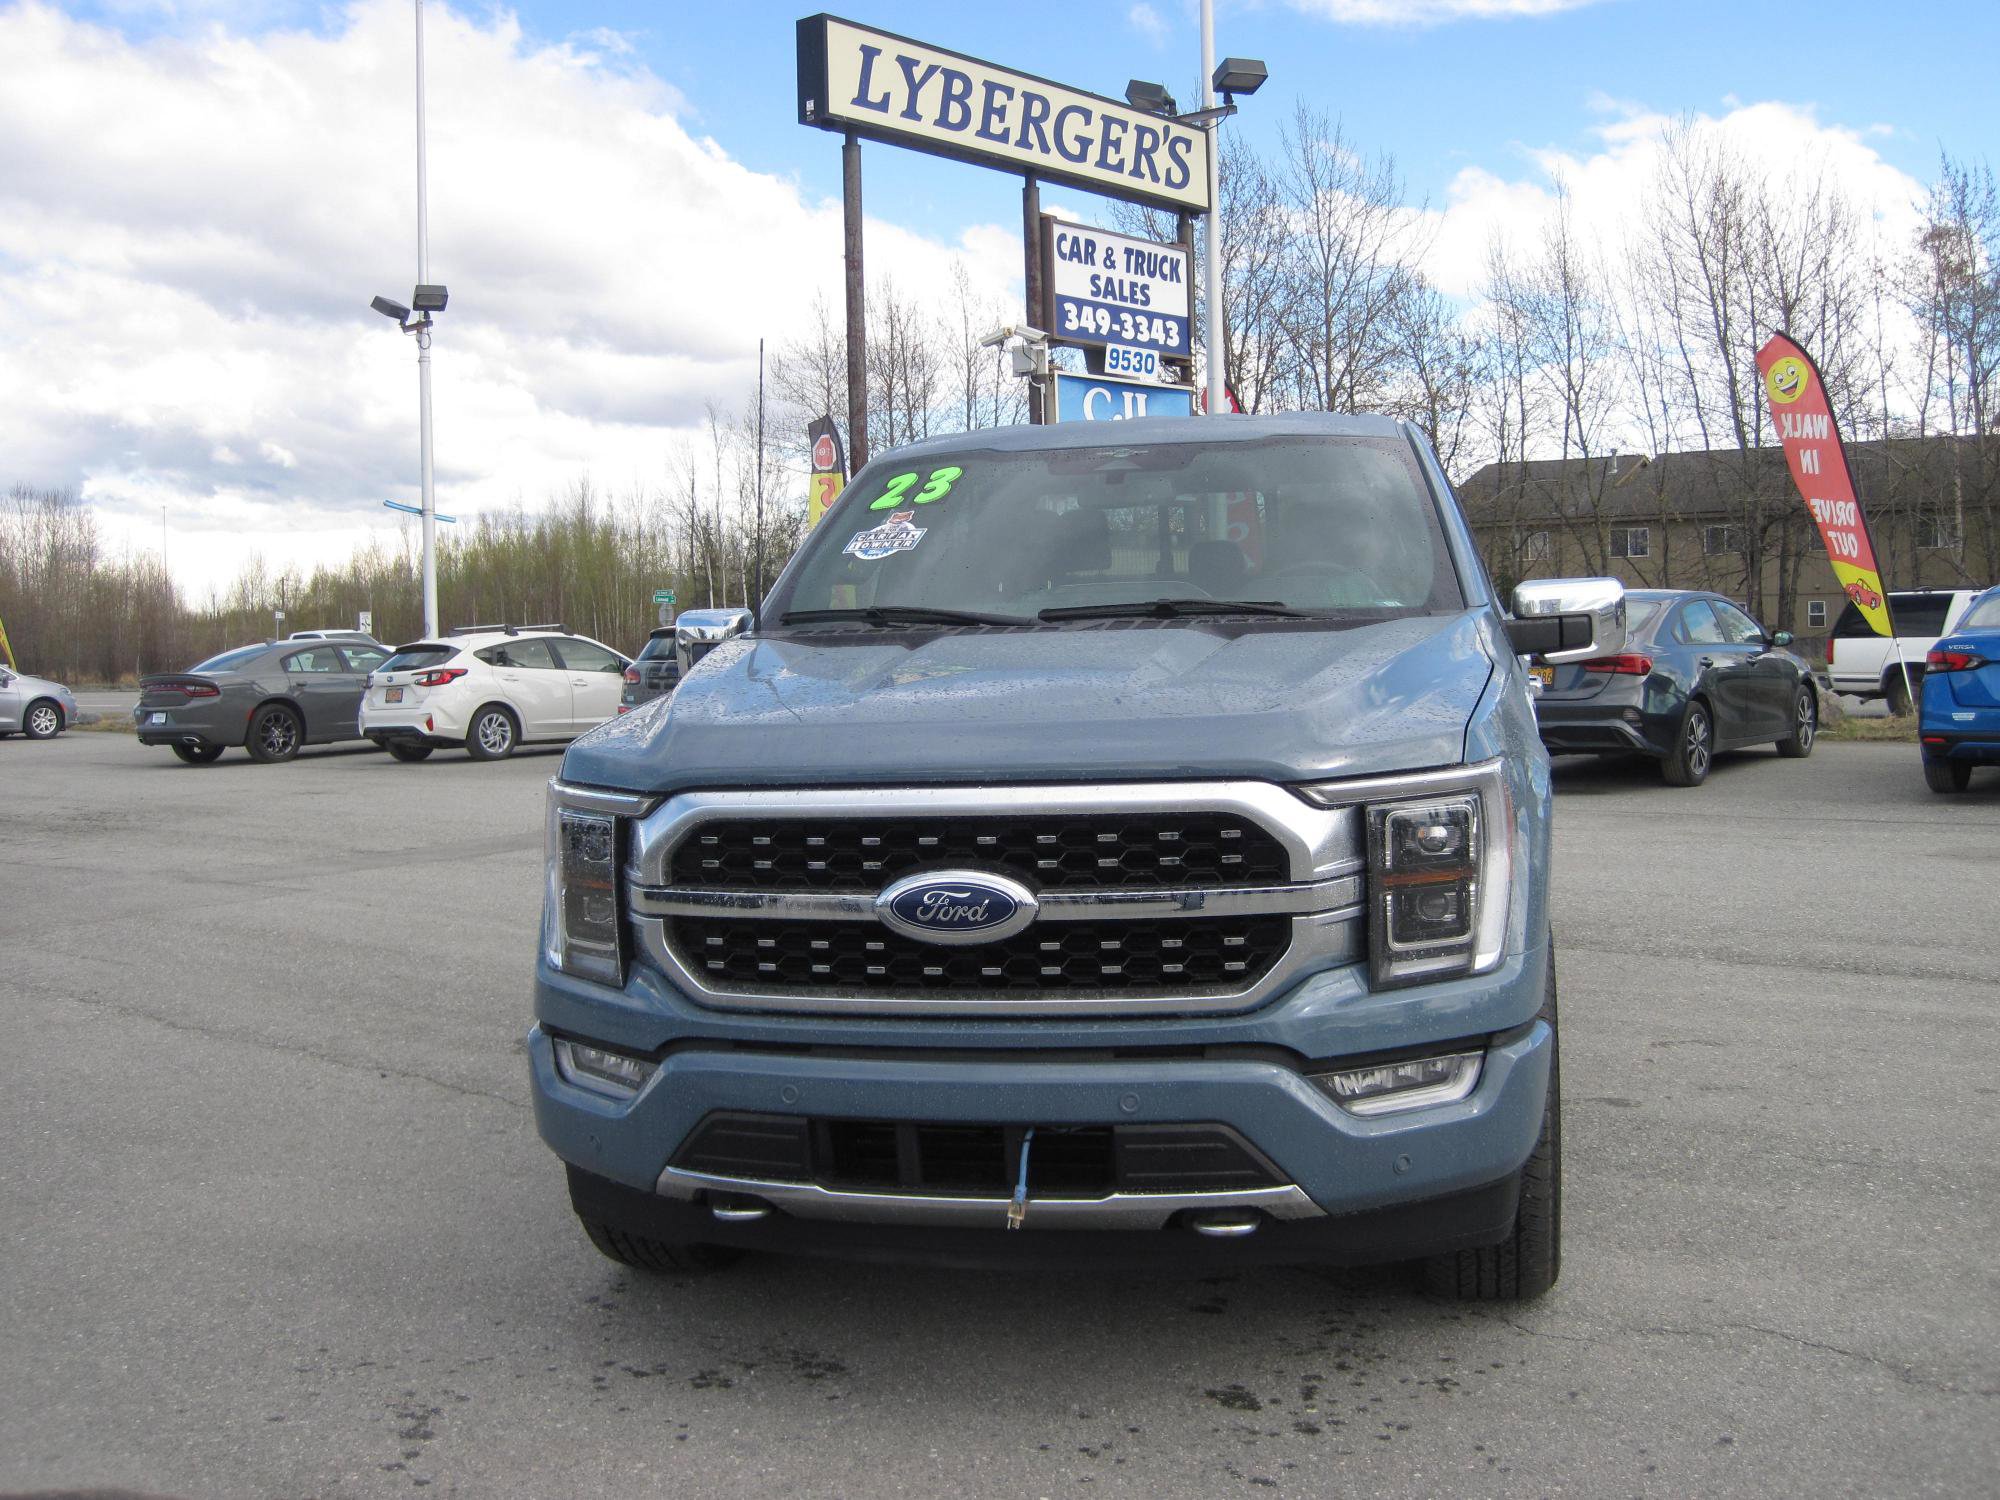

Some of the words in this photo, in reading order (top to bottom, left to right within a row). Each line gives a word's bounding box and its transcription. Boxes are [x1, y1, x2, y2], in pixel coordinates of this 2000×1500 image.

[850, 44, 1193, 191] LYBERGER'S
[1056, 232, 1097, 267] CAR
[1103, 246, 1117, 270] &
[1124, 246, 1182, 284] TRUCK
[1090, 273, 1151, 307] SALES
[1063, 302, 1180, 348] 349-3343
[1108, 347, 1155, 375] 9530
[869, 466, 963, 511] 23
[857, 531, 919, 541] CARFAX
[860, 540, 914, 549] OWNER
[916, 890, 990, 922] Ford
